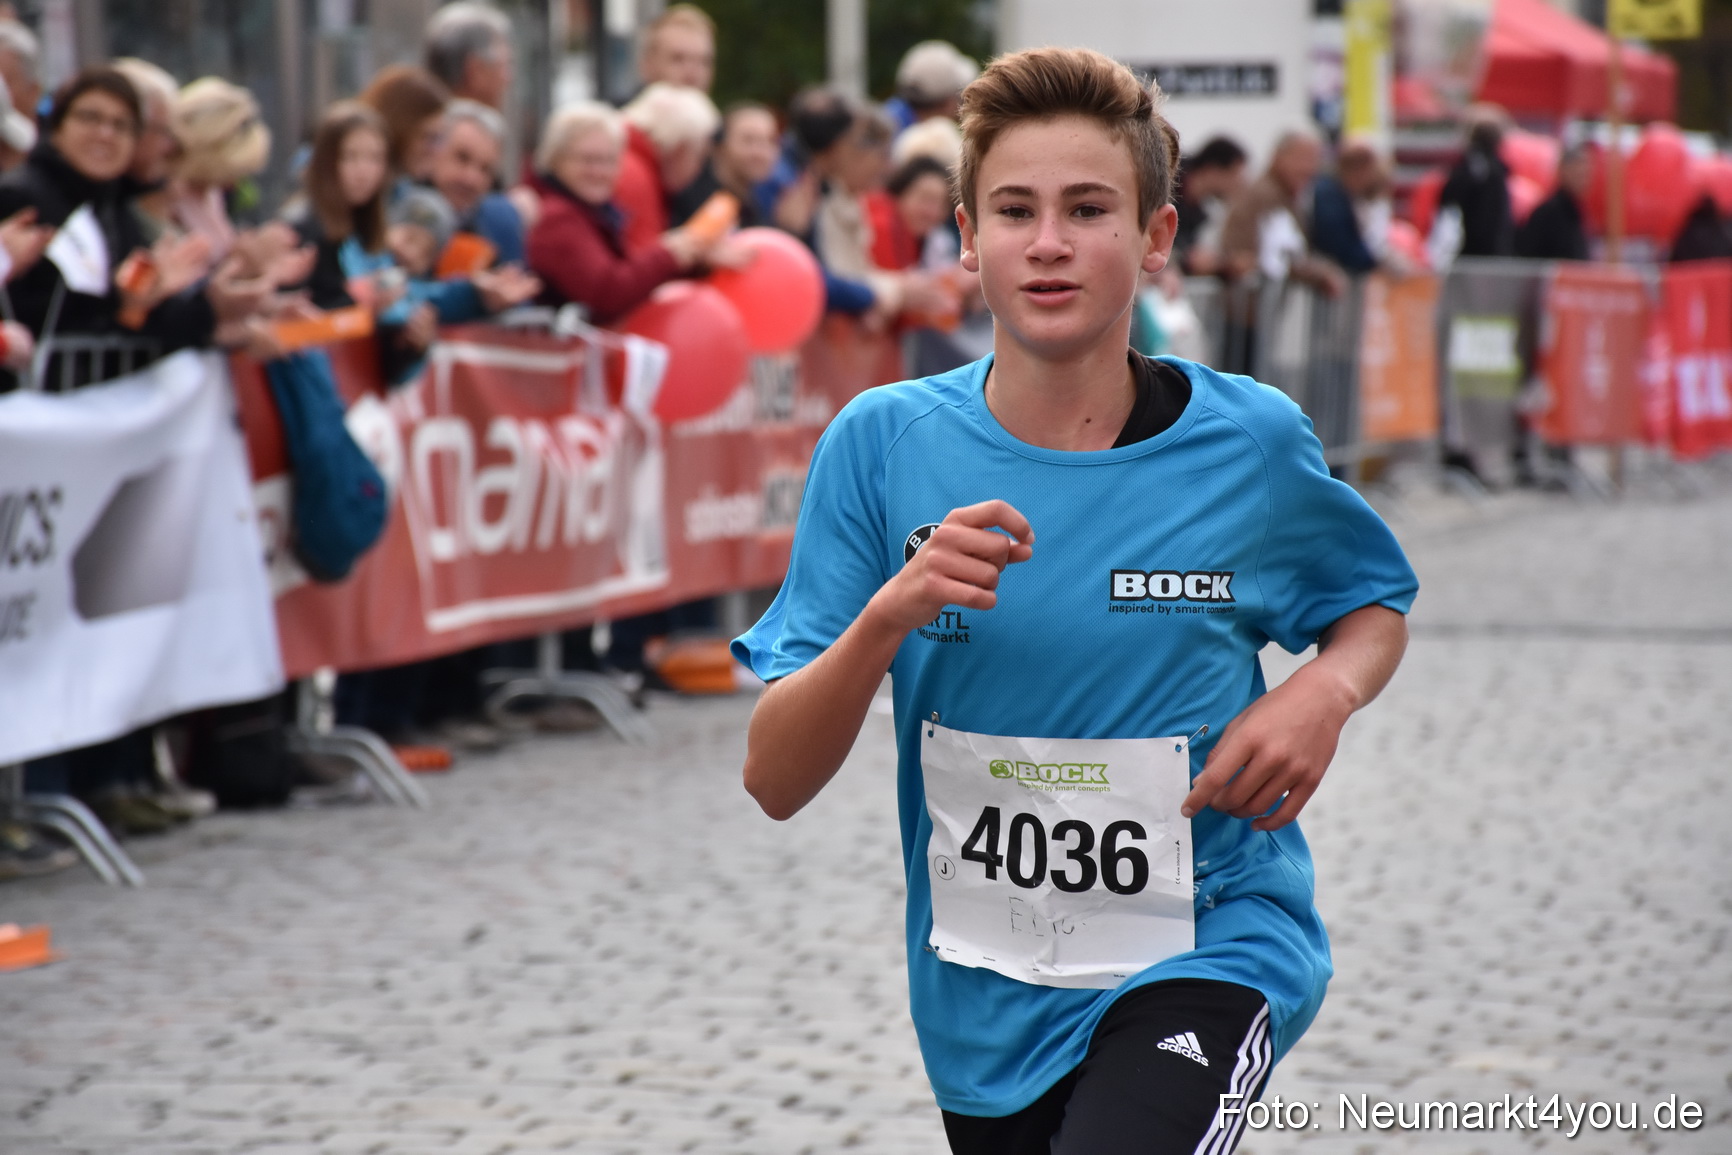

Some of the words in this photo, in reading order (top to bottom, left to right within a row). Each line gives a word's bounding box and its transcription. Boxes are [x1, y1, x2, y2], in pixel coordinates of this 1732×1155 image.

[1111, 570, 1235, 601] BOCK
[1108, 603, 1154, 614] inspired
[1158, 603, 1172, 615] by
[1175, 604, 1204, 614] smart
[926, 611, 970, 629] RTL
[917, 627, 970, 643] Neumarkt
[1016, 761, 1110, 784] BOCK
[1017, 780, 1044, 791] inspired
[1044, 784, 1054, 792] by
[1077, 785, 1111, 793] concepts
[961, 805, 1150, 895] 4036
[941, 862, 948, 875] J
[1156, 1042, 1209, 1067] adidas
